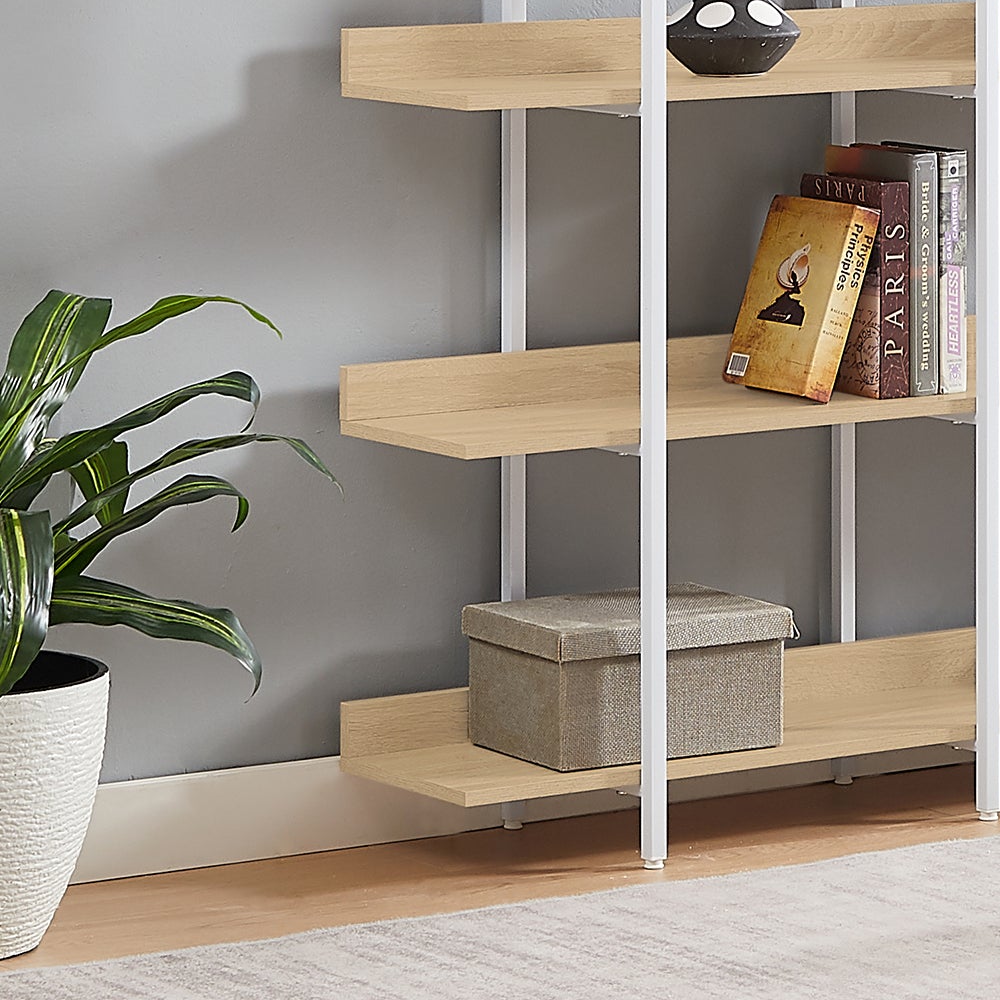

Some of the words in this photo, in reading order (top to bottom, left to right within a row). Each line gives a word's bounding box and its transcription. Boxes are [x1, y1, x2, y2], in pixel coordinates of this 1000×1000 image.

[815, 178, 866, 202] PARIS
[921, 181, 930, 221] Bride
[836, 222, 864, 292] Principles
[850, 235, 874, 289] Physics
[920, 225, 930, 239] &
[884, 223, 906, 358] PARIS
[920, 243, 930, 308] Groom's
[920, 311, 931, 372] wedding
[948, 269, 960, 354] HEARTLESS
